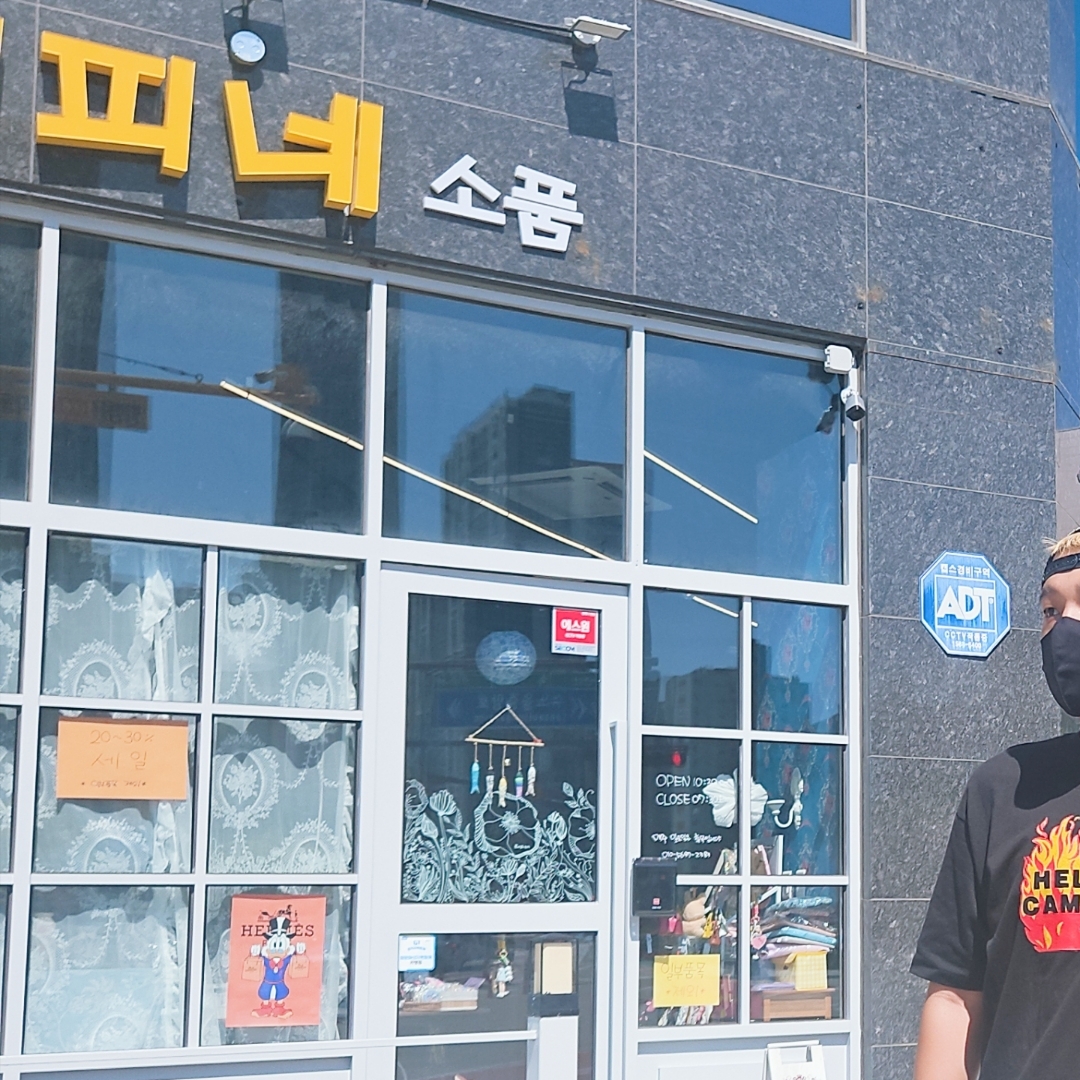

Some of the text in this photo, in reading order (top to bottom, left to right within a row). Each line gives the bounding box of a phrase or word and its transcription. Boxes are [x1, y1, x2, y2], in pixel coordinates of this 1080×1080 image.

[0, 17, 384, 220] 피네
[423, 153, 584, 252] 소품
[937, 585, 995, 623] ADT
[91, 751, 147, 771] 세일
[655, 773, 691, 788] OPEN
[655, 792, 690, 806] CLOSE
[241, 923, 315, 937] HEÈS
